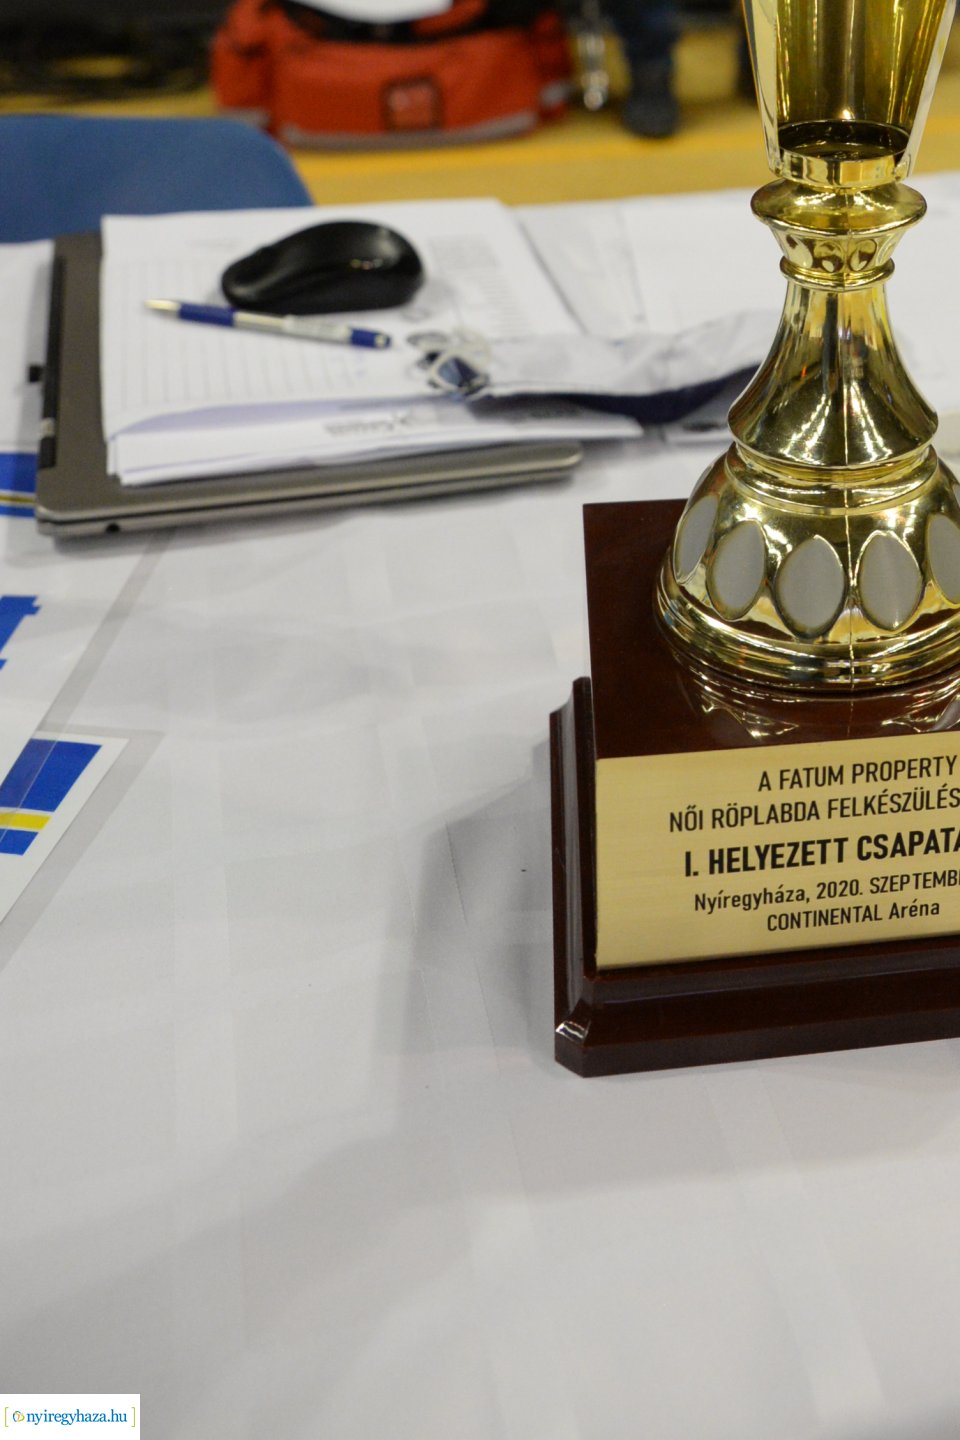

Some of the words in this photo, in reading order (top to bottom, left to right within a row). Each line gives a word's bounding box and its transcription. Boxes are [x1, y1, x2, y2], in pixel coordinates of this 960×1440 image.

[758, 770, 772, 792] A
[779, 765, 844, 790] FATUM
[851, 755, 958, 784] PROPERTY
[669, 804, 704, 833] NŐI
[711, 801, 821, 830] RÖPLABDA
[684, 850, 700, 877] I.
[708, 837, 849, 875] HELYEZETT
[694, 884, 811, 914] Nyíregyháza,
[816, 879, 864, 899] 2020.
[767, 904, 883, 932] CONTINENTAL
[889, 899, 940, 920] Aréna
